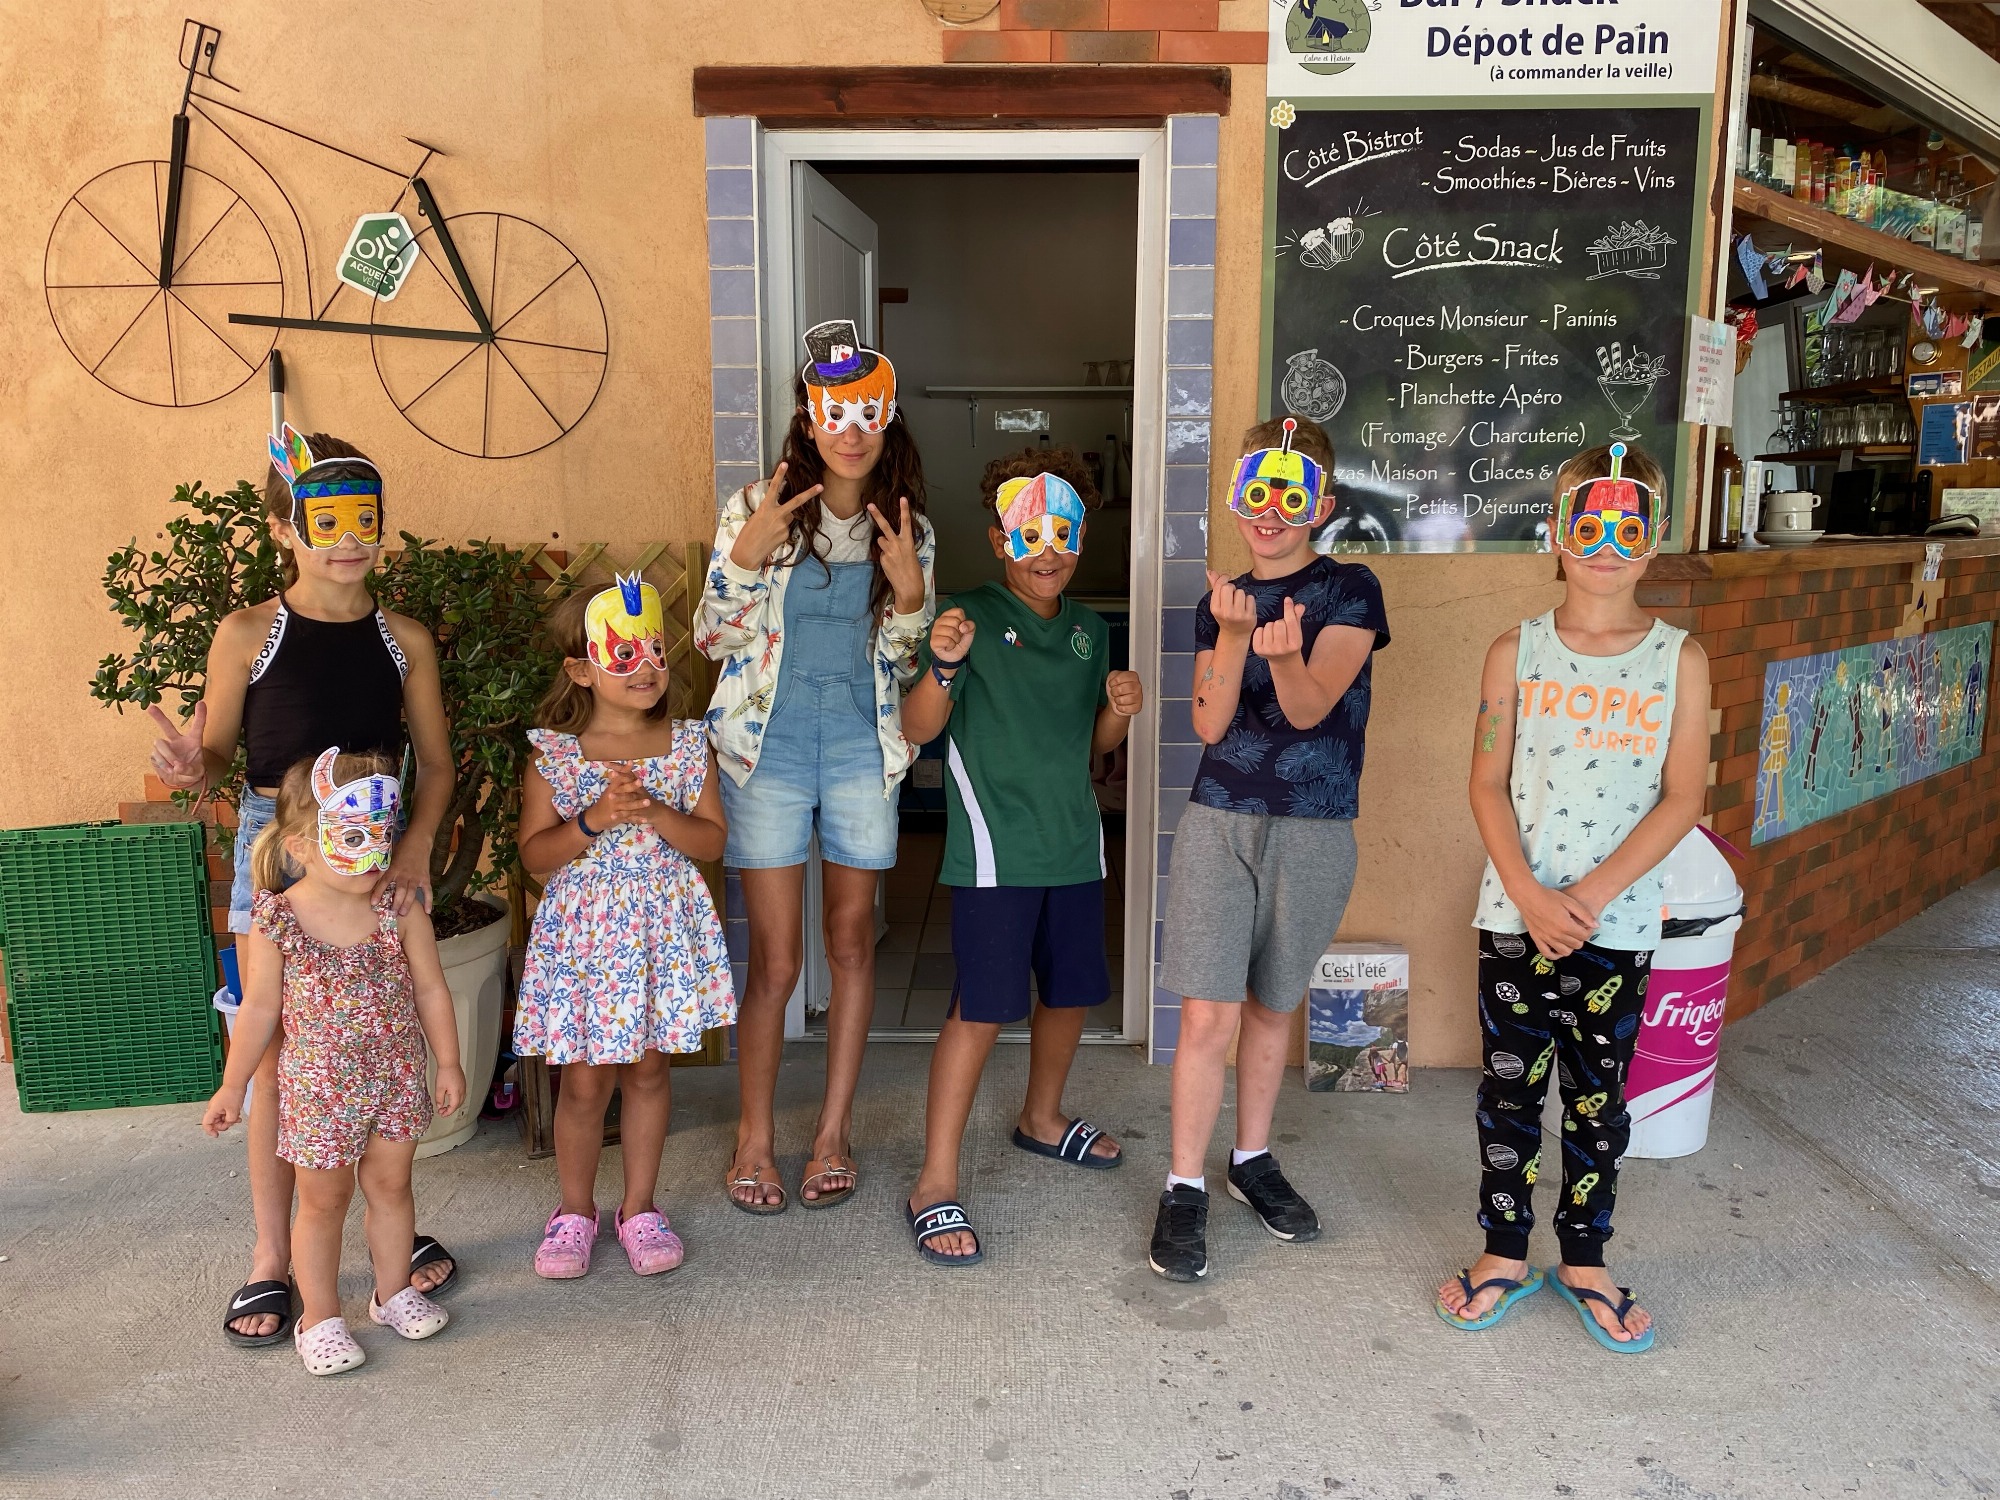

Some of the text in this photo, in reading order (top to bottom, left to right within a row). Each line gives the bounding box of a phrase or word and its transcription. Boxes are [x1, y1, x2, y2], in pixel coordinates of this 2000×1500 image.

[1427, 22, 1669, 65] Dépot de Pain
[1489, 62, 1674, 82] (à commander la veille)
[1283, 126, 1424, 181] Côté Bistrot
[1454, 134, 1521, 163] Sodas
[1540, 134, 1576, 162] Jus
[1581, 134, 1605, 158] de
[1610, 134, 1667, 161] Fruits
[1433, 165, 1537, 194] Smoothies
[1551, 166, 1617, 193] Bières
[1633, 165, 1676, 192] Vins
[1382, 223, 1564, 268] Côté Snack
[350, 260, 389, 285] ACCUEIL
[1352, 304, 1436, 336] Croques
[1439, 304, 1529, 331] Monsieur
[1552, 303, 1618, 331] Paninis
[1406, 344, 1484, 373] Burgers
[1504, 344, 1559, 368] Frites
[1399, 381, 1496, 410] Planchette
[1500, 382, 1563, 413] Apéro
[1360, 420, 1448, 450] (Fromage
[1468, 420, 1587, 449] Charcuterie)
[1370, 459, 1438, 484] Maison
[1468, 457, 1535, 484] Glaces
[1538, 464, 1554, 481] &
[1405, 493, 1458, 519] Petits
[259, 640, 275, 659] GO
[389, 644, 404, 662] GO
[1518, 680, 1665, 733] TROPIC
[1573, 729, 1658, 757] SURFER
[1321, 962, 1387, 978] C'est l'été
[1373, 979, 1398, 992] Gratuit
[926, 1210, 965, 1229] FILA
